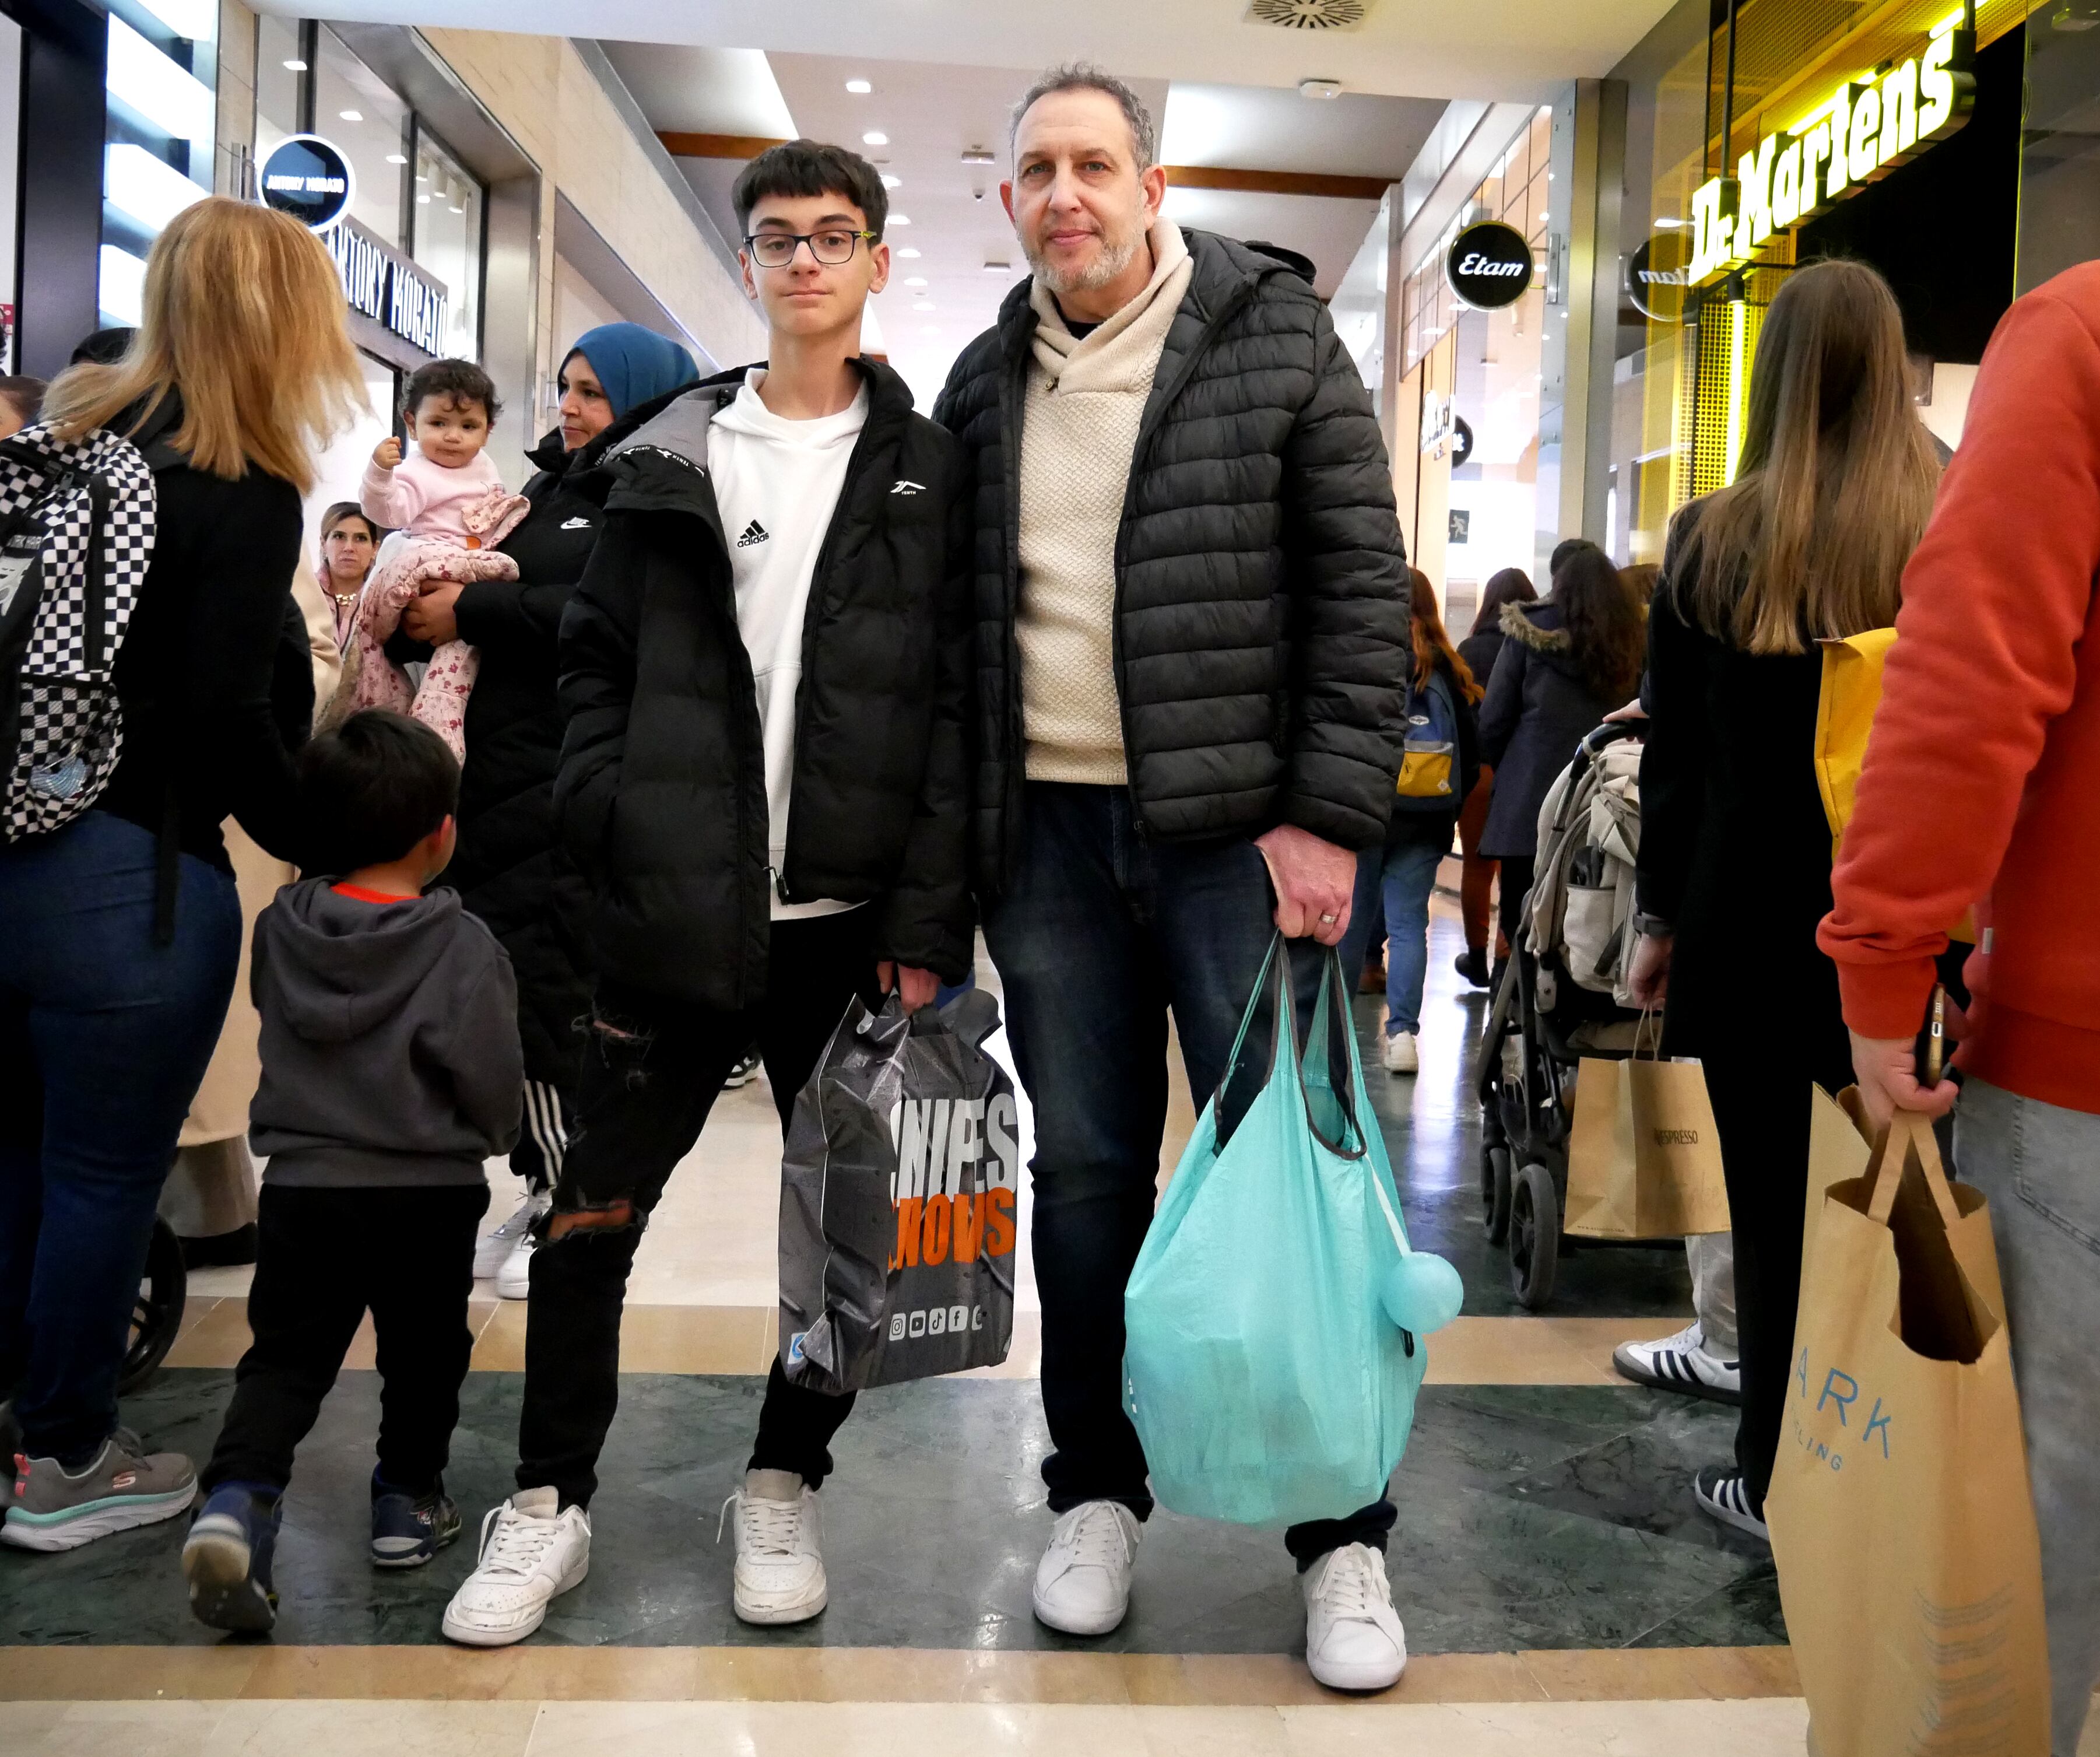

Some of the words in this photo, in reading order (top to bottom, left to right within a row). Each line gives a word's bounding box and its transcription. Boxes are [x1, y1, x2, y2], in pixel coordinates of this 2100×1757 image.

[1459, 253, 1523, 276] Etam
[391, 261, 447, 359] MORATO
[672, 454, 690, 467] TENTH
[737, 532, 770, 548] adidas
[1654, 1127, 1699, 1146] NESPRESSO
[888, 1187, 1016, 1270] NOWS
